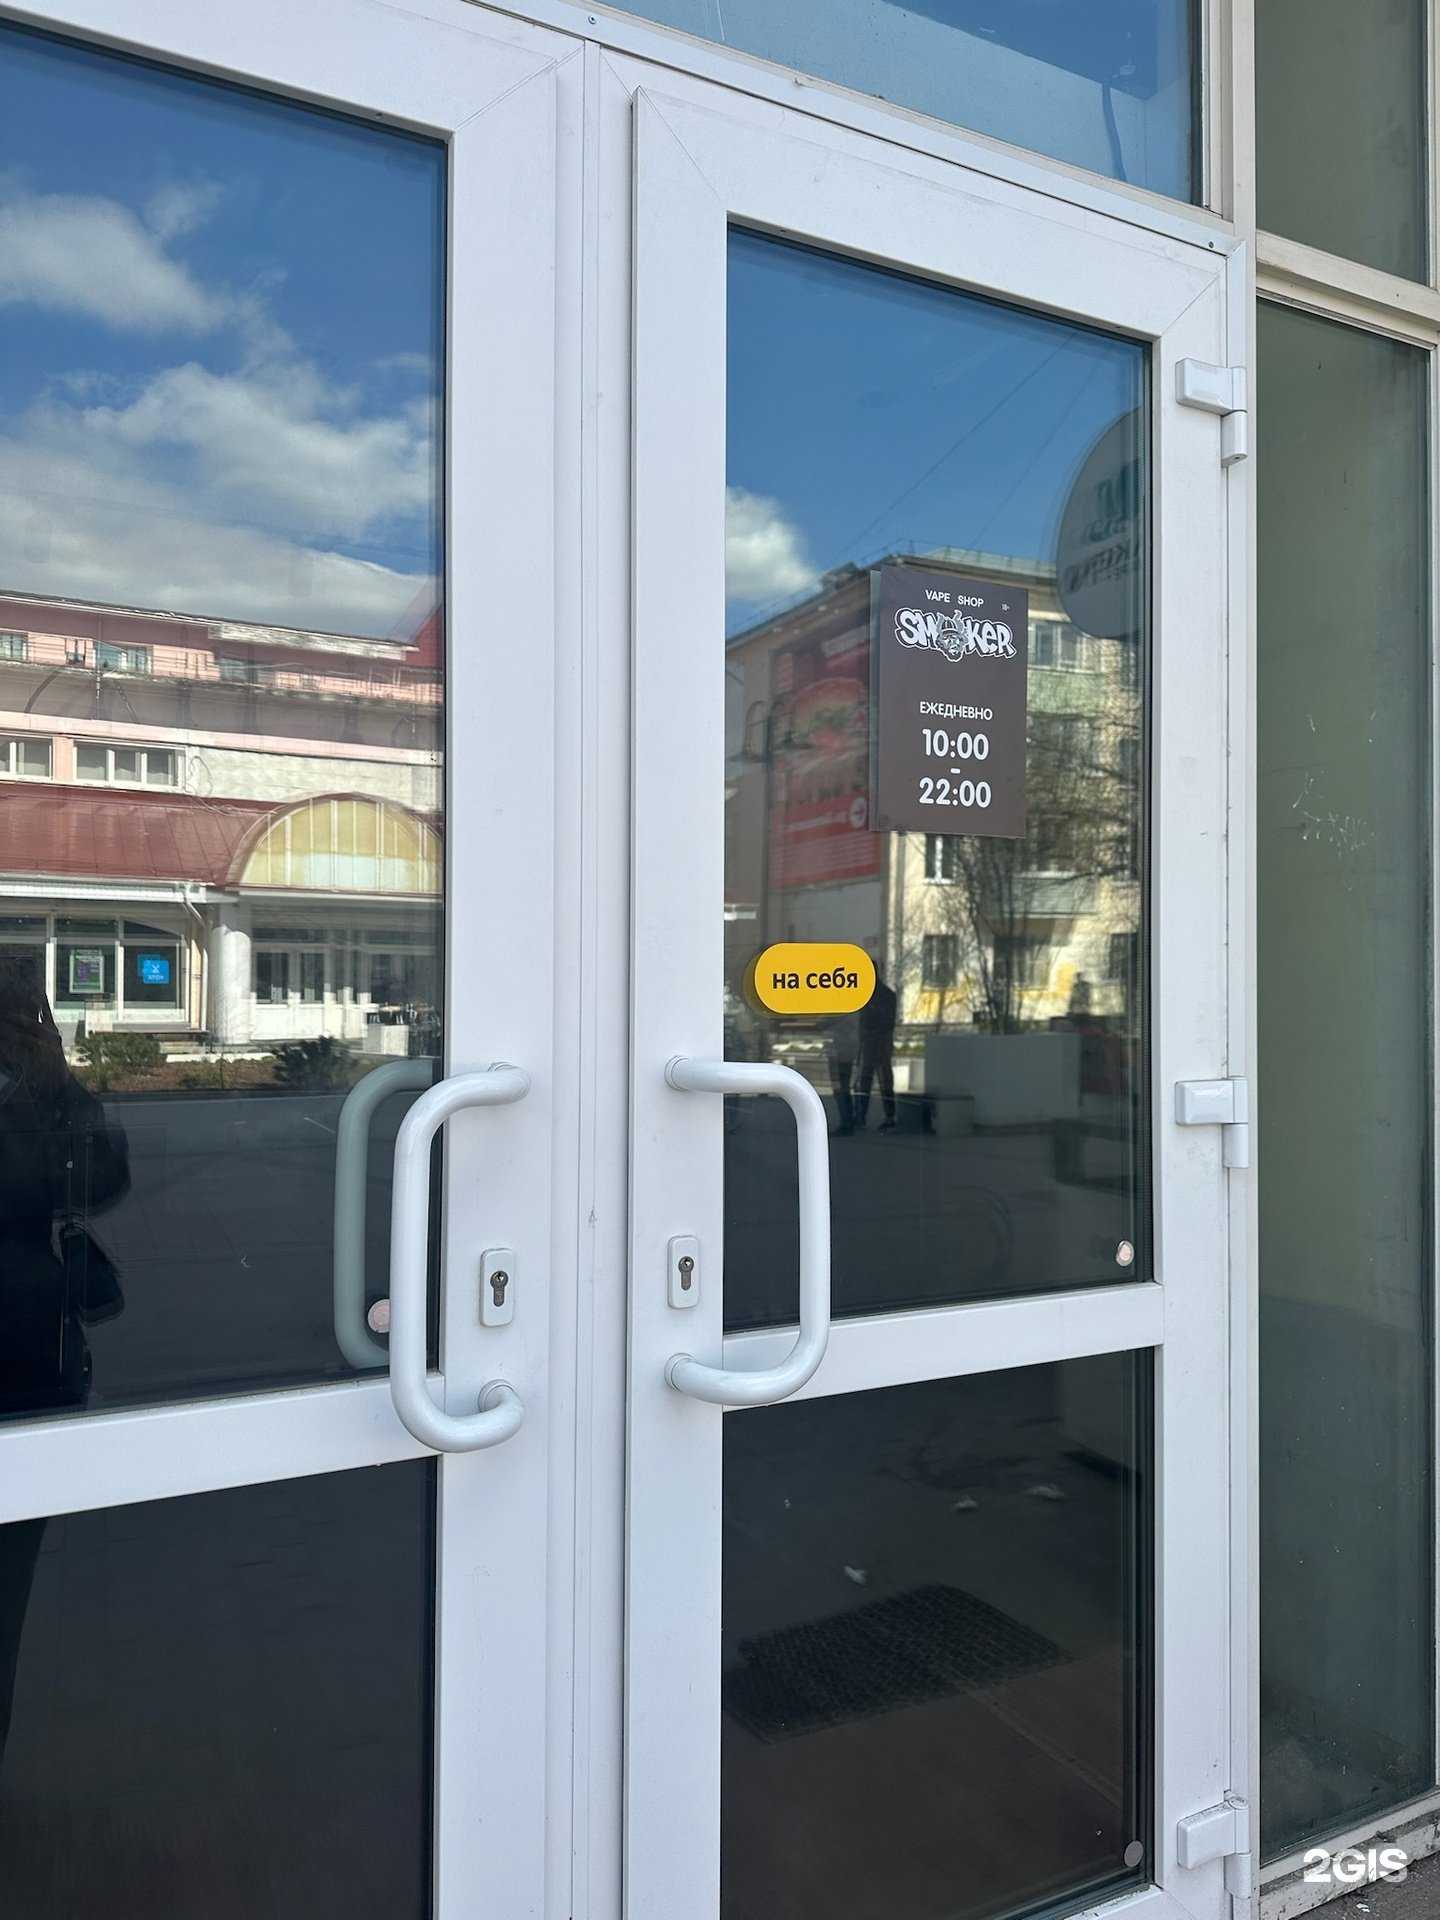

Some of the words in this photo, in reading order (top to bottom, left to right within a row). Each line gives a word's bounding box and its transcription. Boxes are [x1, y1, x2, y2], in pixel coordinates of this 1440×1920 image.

[925, 590, 951, 603] VAPE
[957, 595, 984, 607] SHOP
[919, 701, 993, 721] ЕЖЕДНЕВНО
[922, 728, 989, 760] 10:00
[919, 777, 992, 808] 22:00
[772, 972, 800, 989] на
[806, 967, 858, 989] себя
